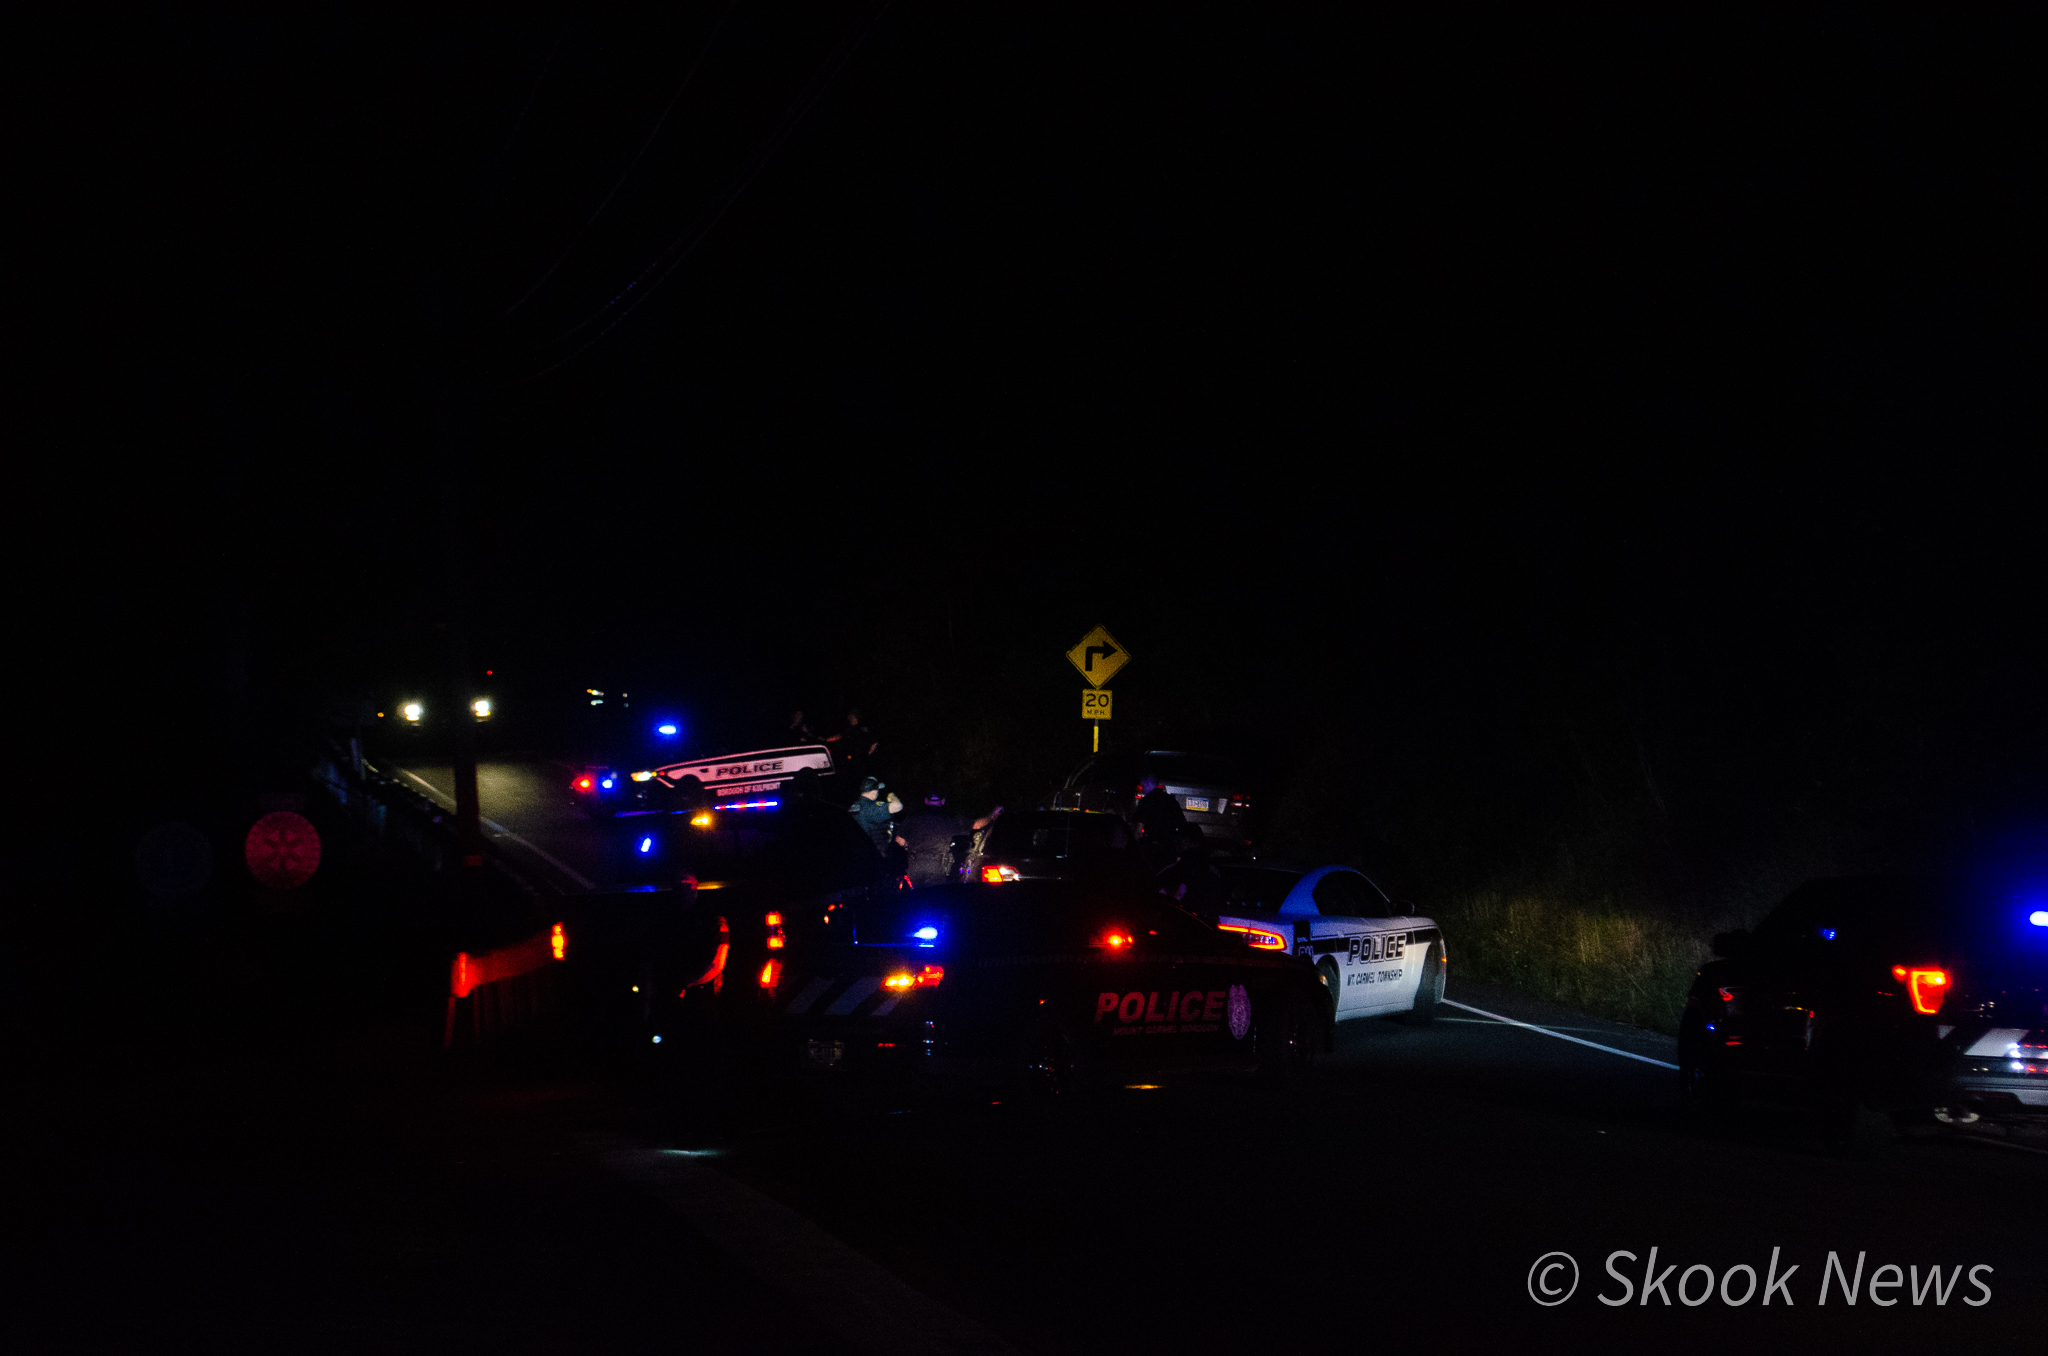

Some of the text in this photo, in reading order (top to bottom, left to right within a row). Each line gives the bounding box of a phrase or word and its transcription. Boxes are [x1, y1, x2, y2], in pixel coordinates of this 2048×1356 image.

[1085, 693, 1109, 708] 20
[717, 761, 783, 776] POLICE
[1346, 932, 1407, 966] POLICE
[1356, 971, 1375, 985] CARMEL
[1377, 968, 1403, 983] TOWNSHIP
[1094, 990, 1227, 1023] POLICE
[1112, 1026, 1143, 1036] MOUNT
[1145, 1025, 1177, 1035] CARMEL
